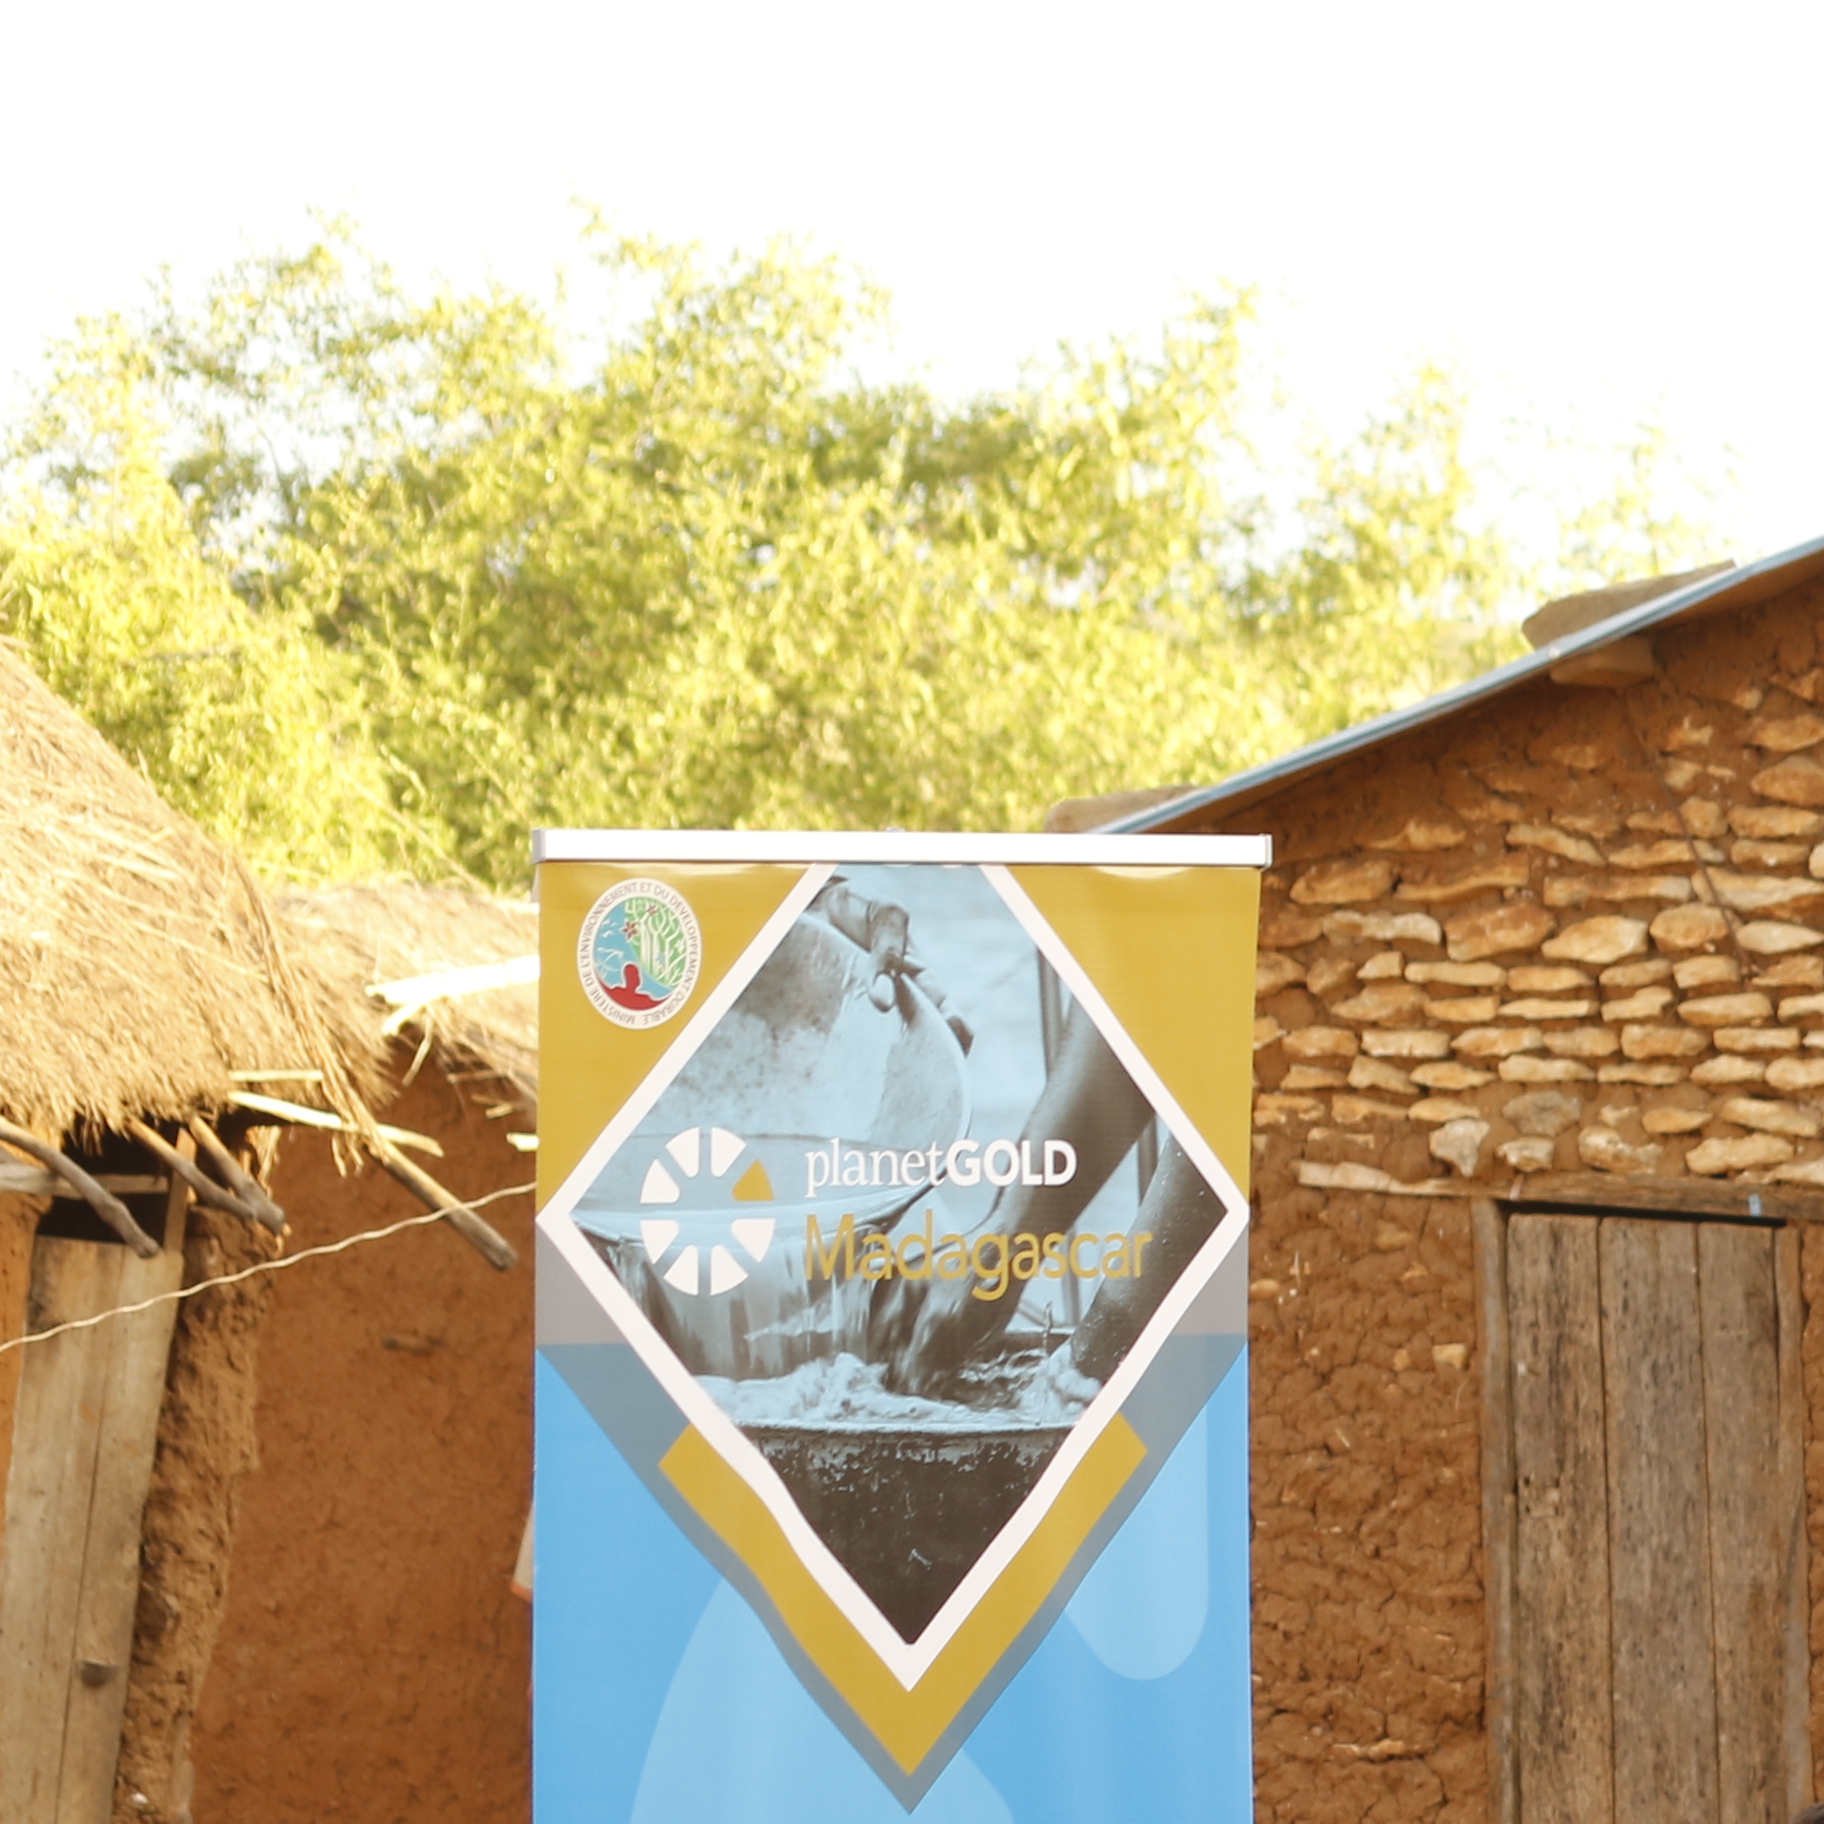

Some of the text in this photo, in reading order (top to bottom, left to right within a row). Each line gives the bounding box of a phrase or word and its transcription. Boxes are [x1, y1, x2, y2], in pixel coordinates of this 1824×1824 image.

[639, 882, 652, 893] ET
[653, 885, 670, 899] DU
[582, 971, 596, 985] DE
[642, 991, 686, 1025] DURABLE
[804, 1137, 1077, 1197] planetGOLD
[804, 1209, 1153, 1301] Madagascar
